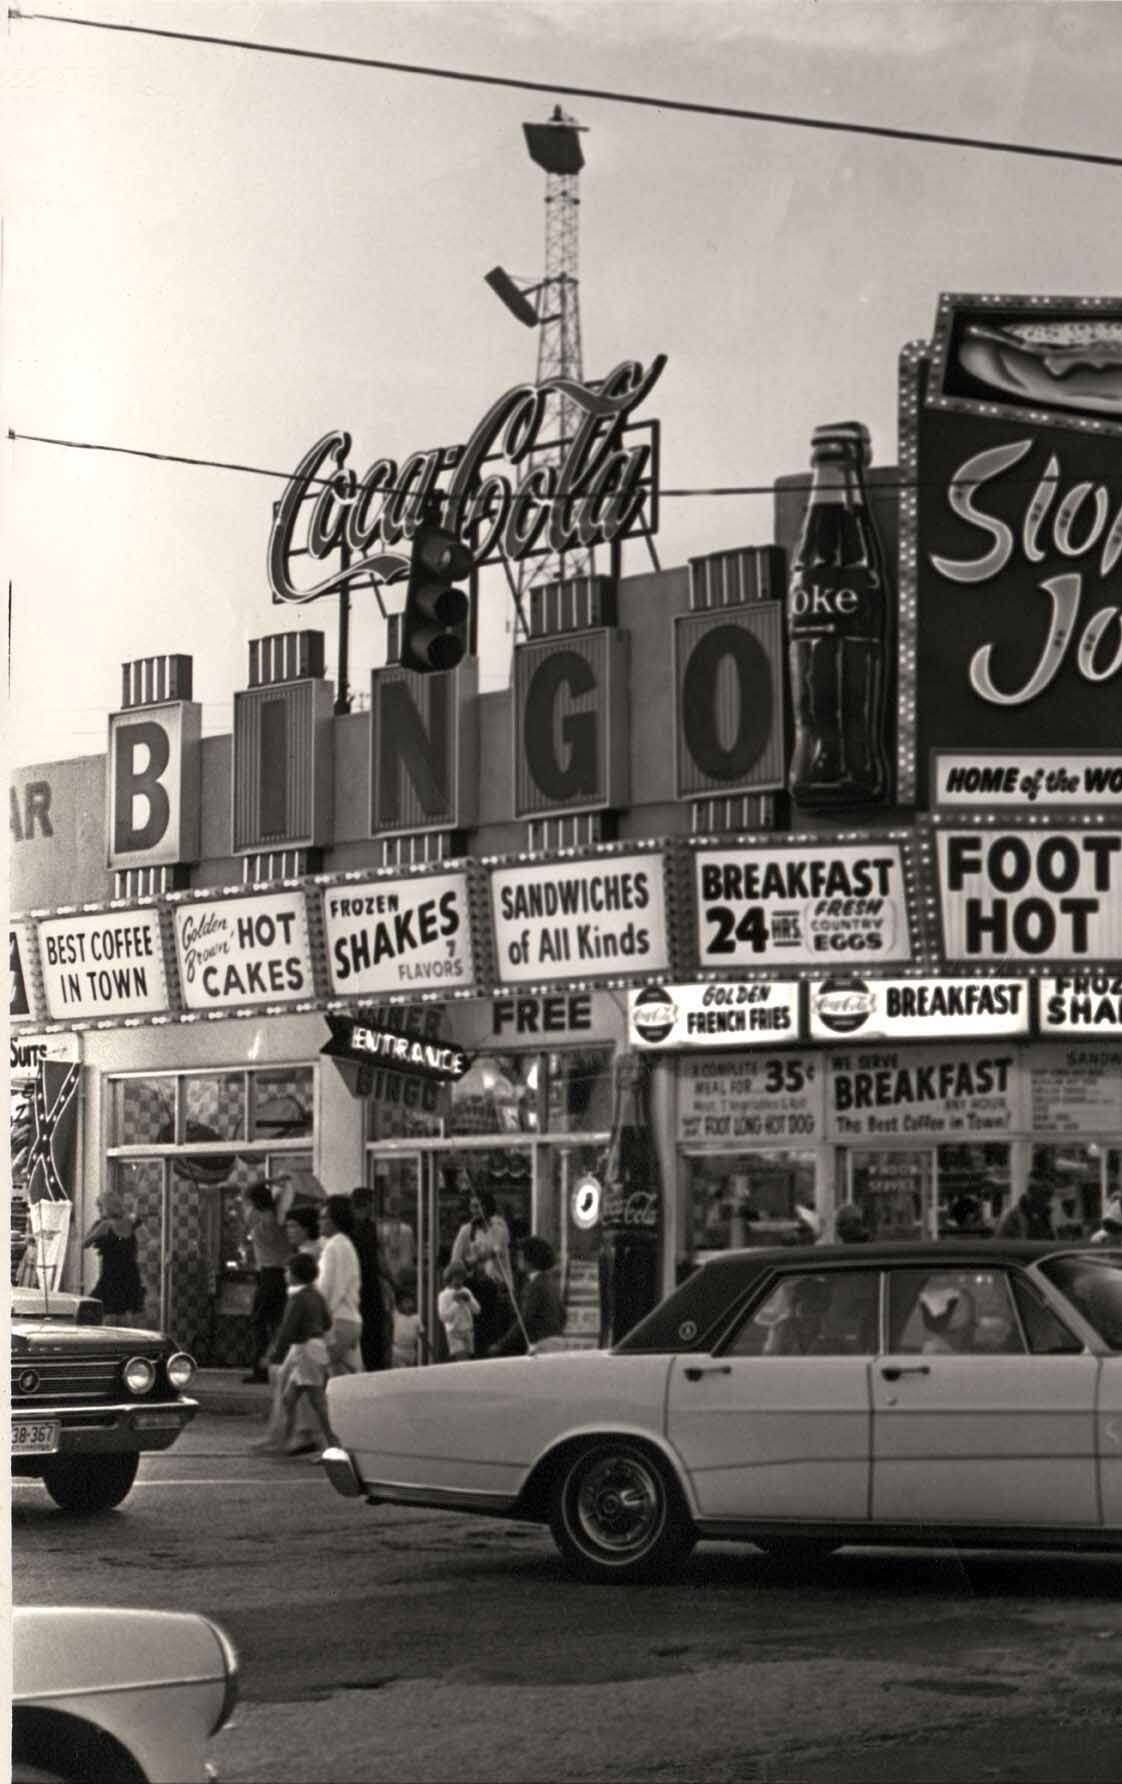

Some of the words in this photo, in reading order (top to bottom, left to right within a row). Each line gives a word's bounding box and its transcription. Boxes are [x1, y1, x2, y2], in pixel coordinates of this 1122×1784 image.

[790, 584, 859, 616] oke
[114, 622, 774, 854] BINGO
[946, 766, 1019, 794] HOME
[1019, 768, 1045, 801] of
[1045, 768, 1080, 794] the
[702, 858, 895, 901] BREAKFAST
[946, 834, 1122, 894] FOOT
[330, 893, 400, 919] FROZEN
[501, 872, 650, 921] SANDWICHES
[814, 899, 885, 917] FRESH
[181, 910, 230, 951] Golden
[236, 910, 297, 950] HOT
[333, 889, 461, 981] SHAKES
[508, 928, 531, 966] of
[538, 926, 571, 962] All
[576, 922, 651, 960] Kinds
[706, 905, 769, 955] 24
[771, 917, 802, 940] HRS
[810, 917, 884, 932] COUNTRY
[813, 932, 884, 952] EGGS
[965, 897, 1100, 955] HOT
[46, 931, 85, 966] BEST
[85, 924, 154, 962] COFFEE
[446, 939, 457, 959] 7
[59, 973, 83, 1004] IN
[87, 965, 149, 1002] TOWN
[202, 956, 306, 998] CAKES
[397, 958, 465, 983] FLAVORS
[702, 984, 772, 1008] GOLDEN
[886, 983, 1023, 1018] BREAKFAST
[491, 998, 593, 1036] FREE
[686, 1010, 746, 1036] FRENCH
[750, 1006, 792, 1033] FRIES
[351, 1024, 465, 1076] ENTRANCE
[833, 1055, 1014, 1112] BREAKFAST
